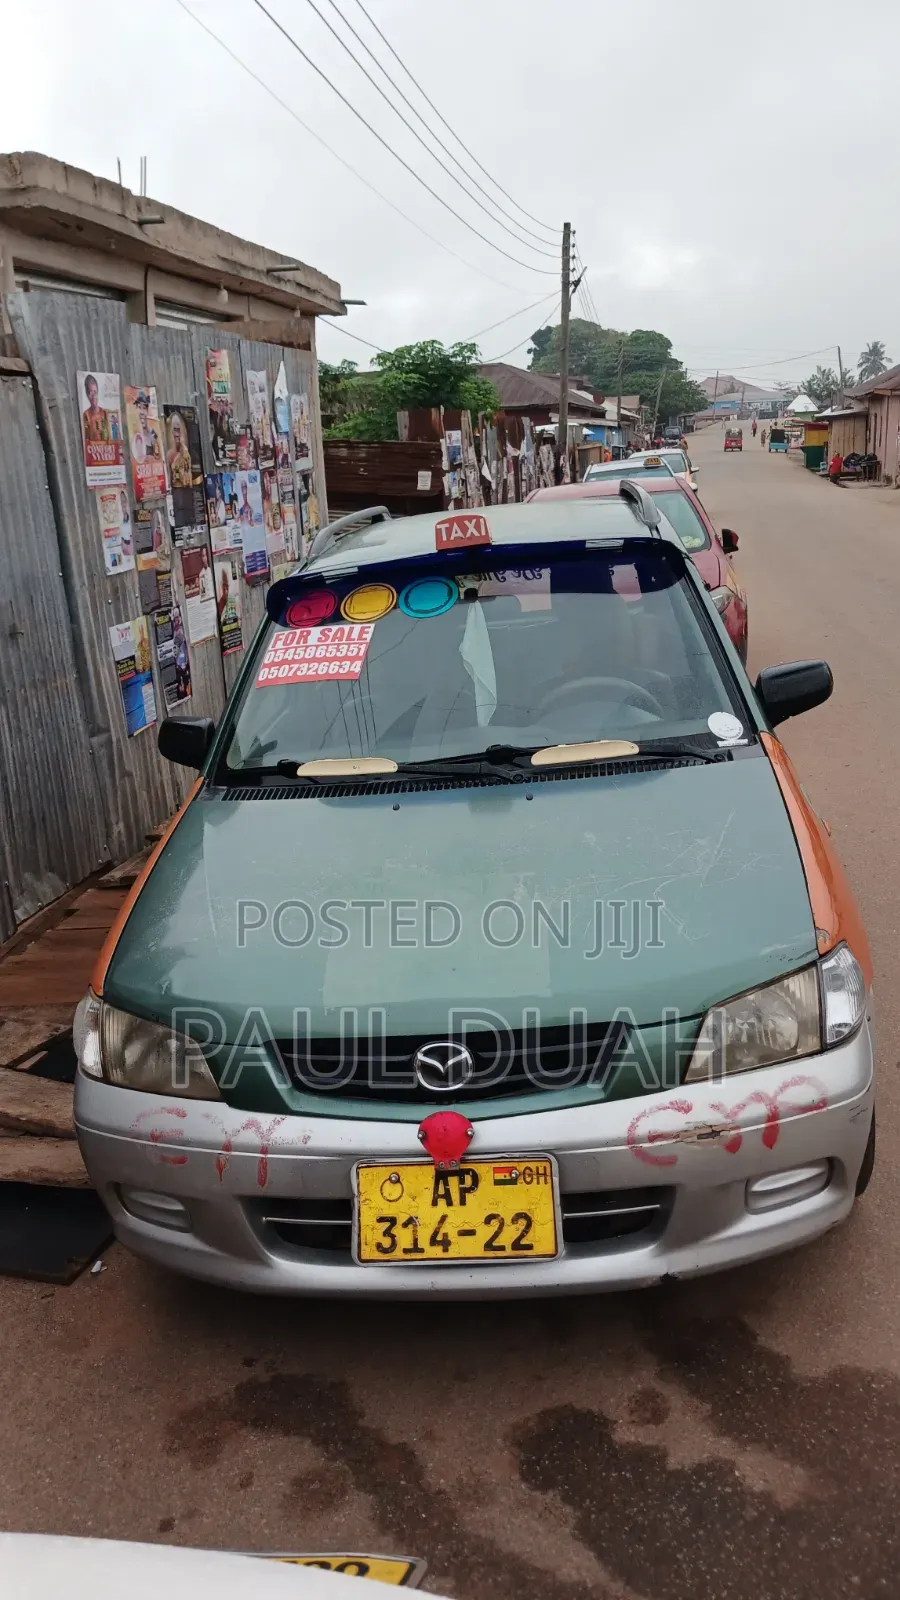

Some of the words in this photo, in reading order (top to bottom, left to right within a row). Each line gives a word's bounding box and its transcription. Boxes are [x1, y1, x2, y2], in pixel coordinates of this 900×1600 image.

[436, 518, 486, 542] TAXI
[271, 629, 311, 649] FOR
[317, 626, 371, 643] SALE
[264, 643, 366, 664] 0545865351
[258, 660, 362, 681] 0507326634
[431, 1167, 480, 1207] AP
[522, 1166, 548, 1185] GH
[375, 1212, 534, 1254] 314-22
